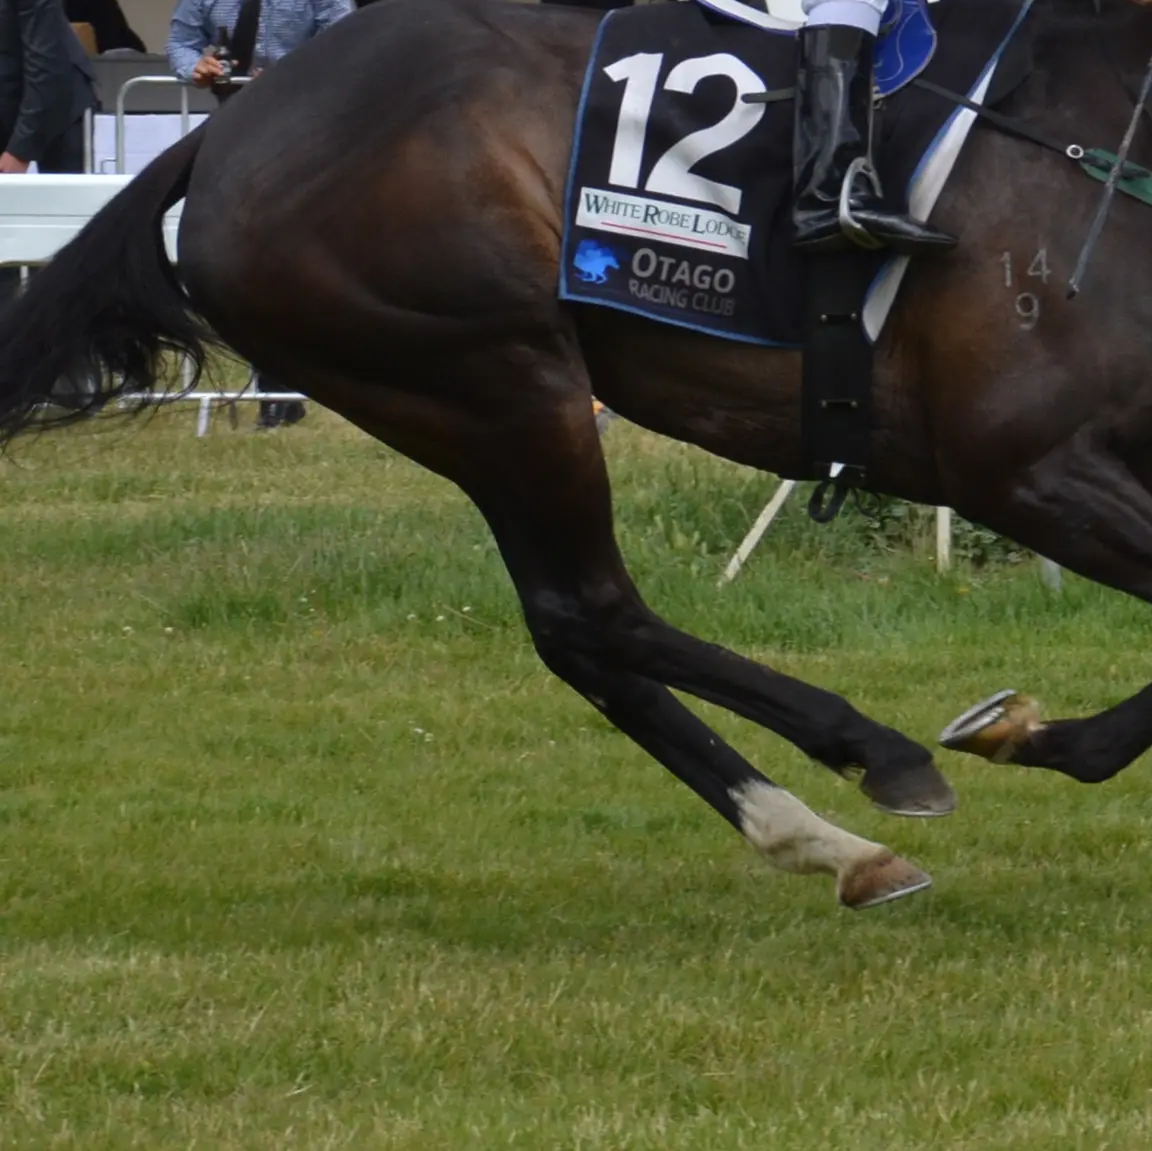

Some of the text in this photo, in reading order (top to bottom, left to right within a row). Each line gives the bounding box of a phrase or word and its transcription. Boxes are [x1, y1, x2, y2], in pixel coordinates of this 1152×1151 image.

[603, 52, 767, 215] 12
[584, 193, 643, 220] WHITE
[643, 203, 692, 229] ROBE
[631, 247, 736, 294] OTAGO
[628, 278, 735, 316] RACING CLUB
